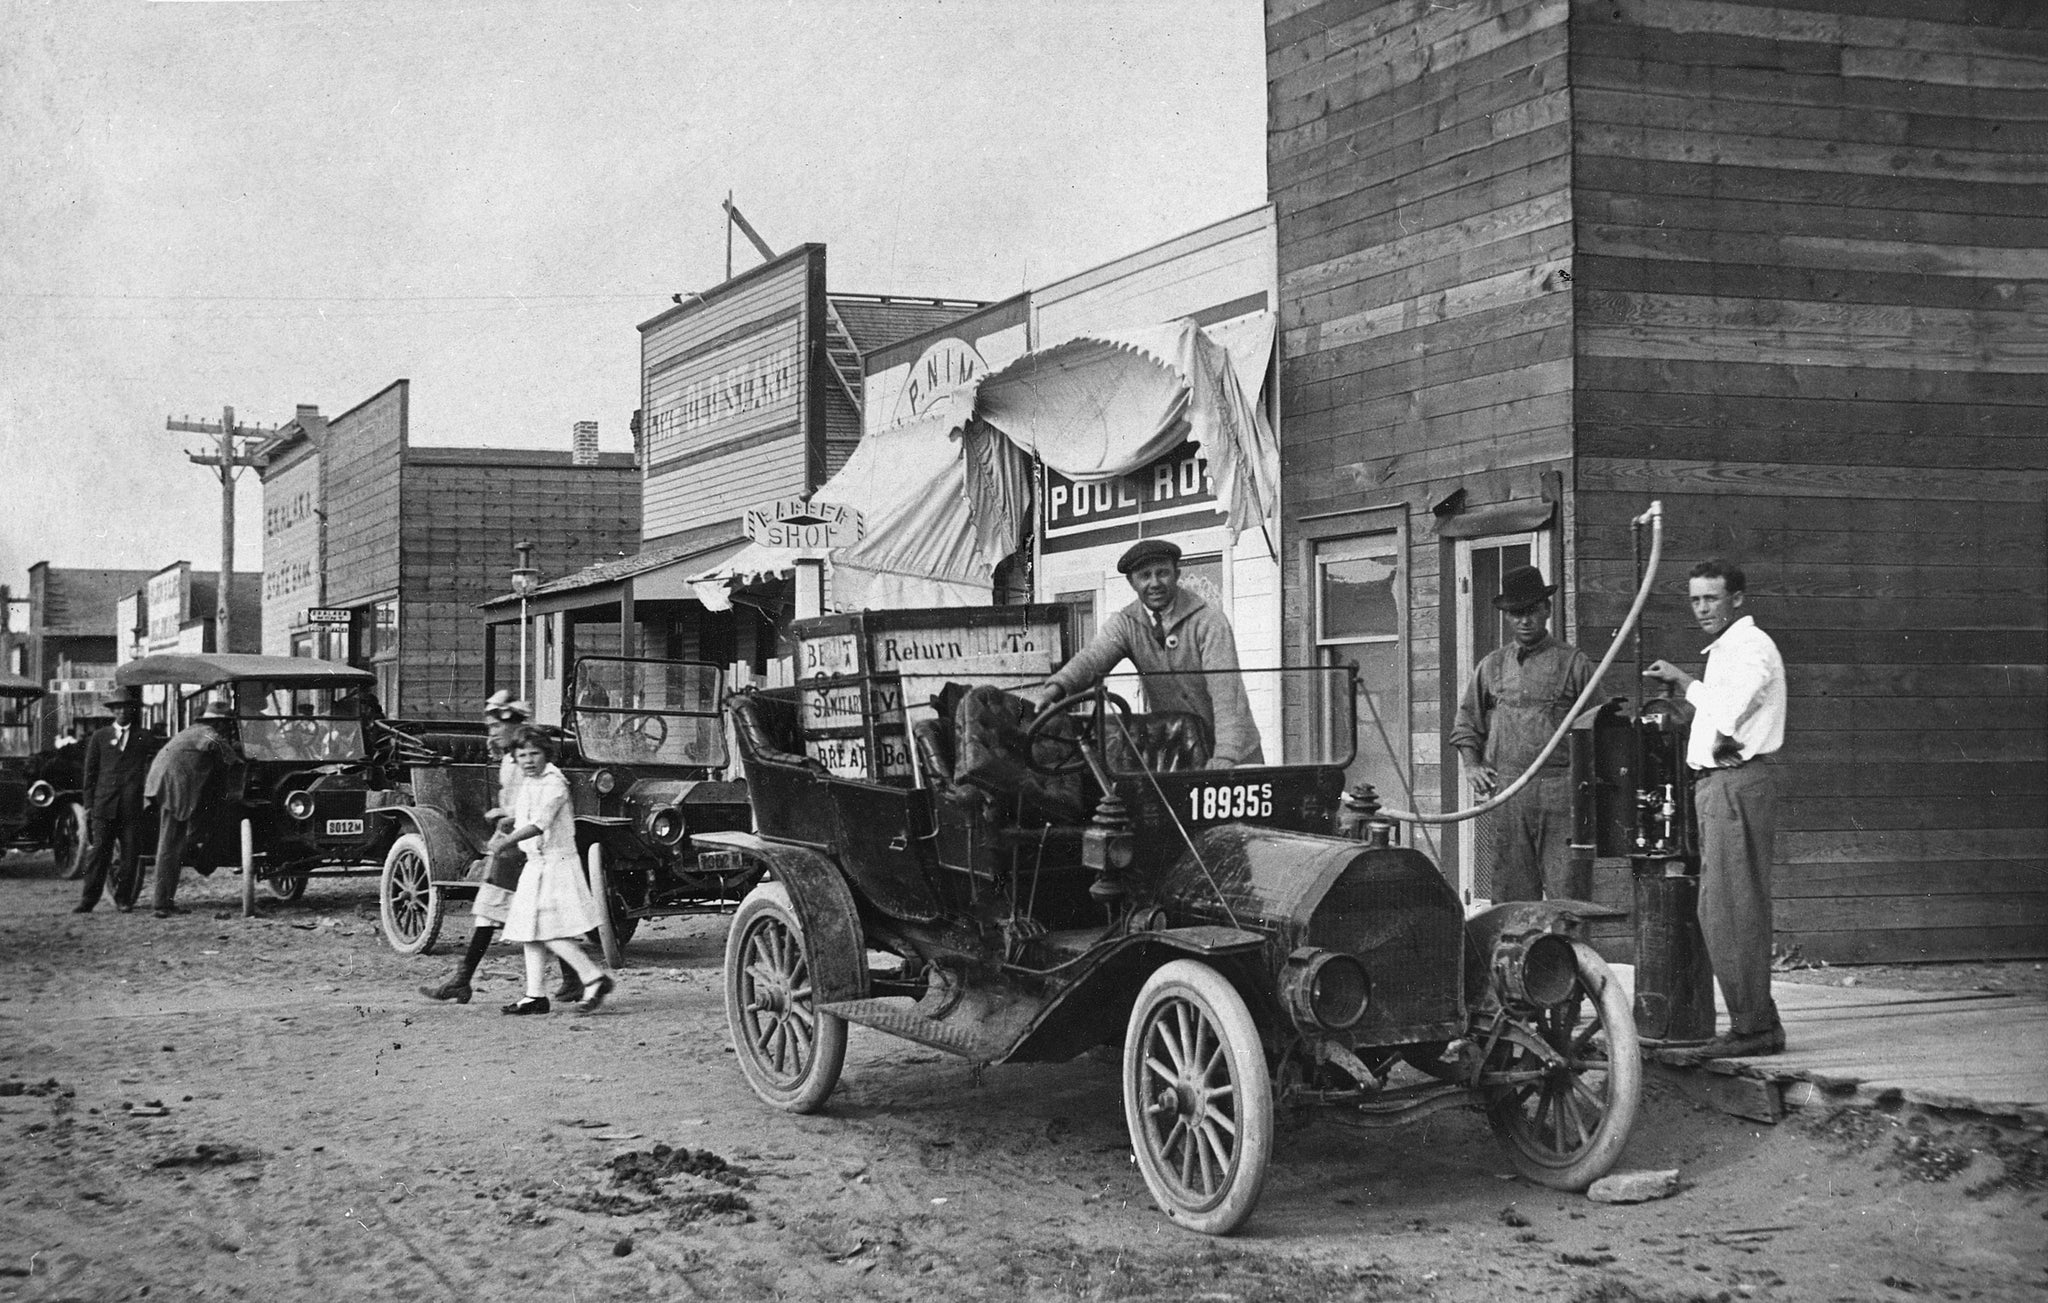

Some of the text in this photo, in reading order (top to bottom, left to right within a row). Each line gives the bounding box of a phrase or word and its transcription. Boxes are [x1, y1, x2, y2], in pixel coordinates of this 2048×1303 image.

[1051, 481, 1137, 521] POOL
[768, 524, 838, 548] SHOP
[885, 639, 963, 662] Return
[1190, 784, 1260, 821] 18935
